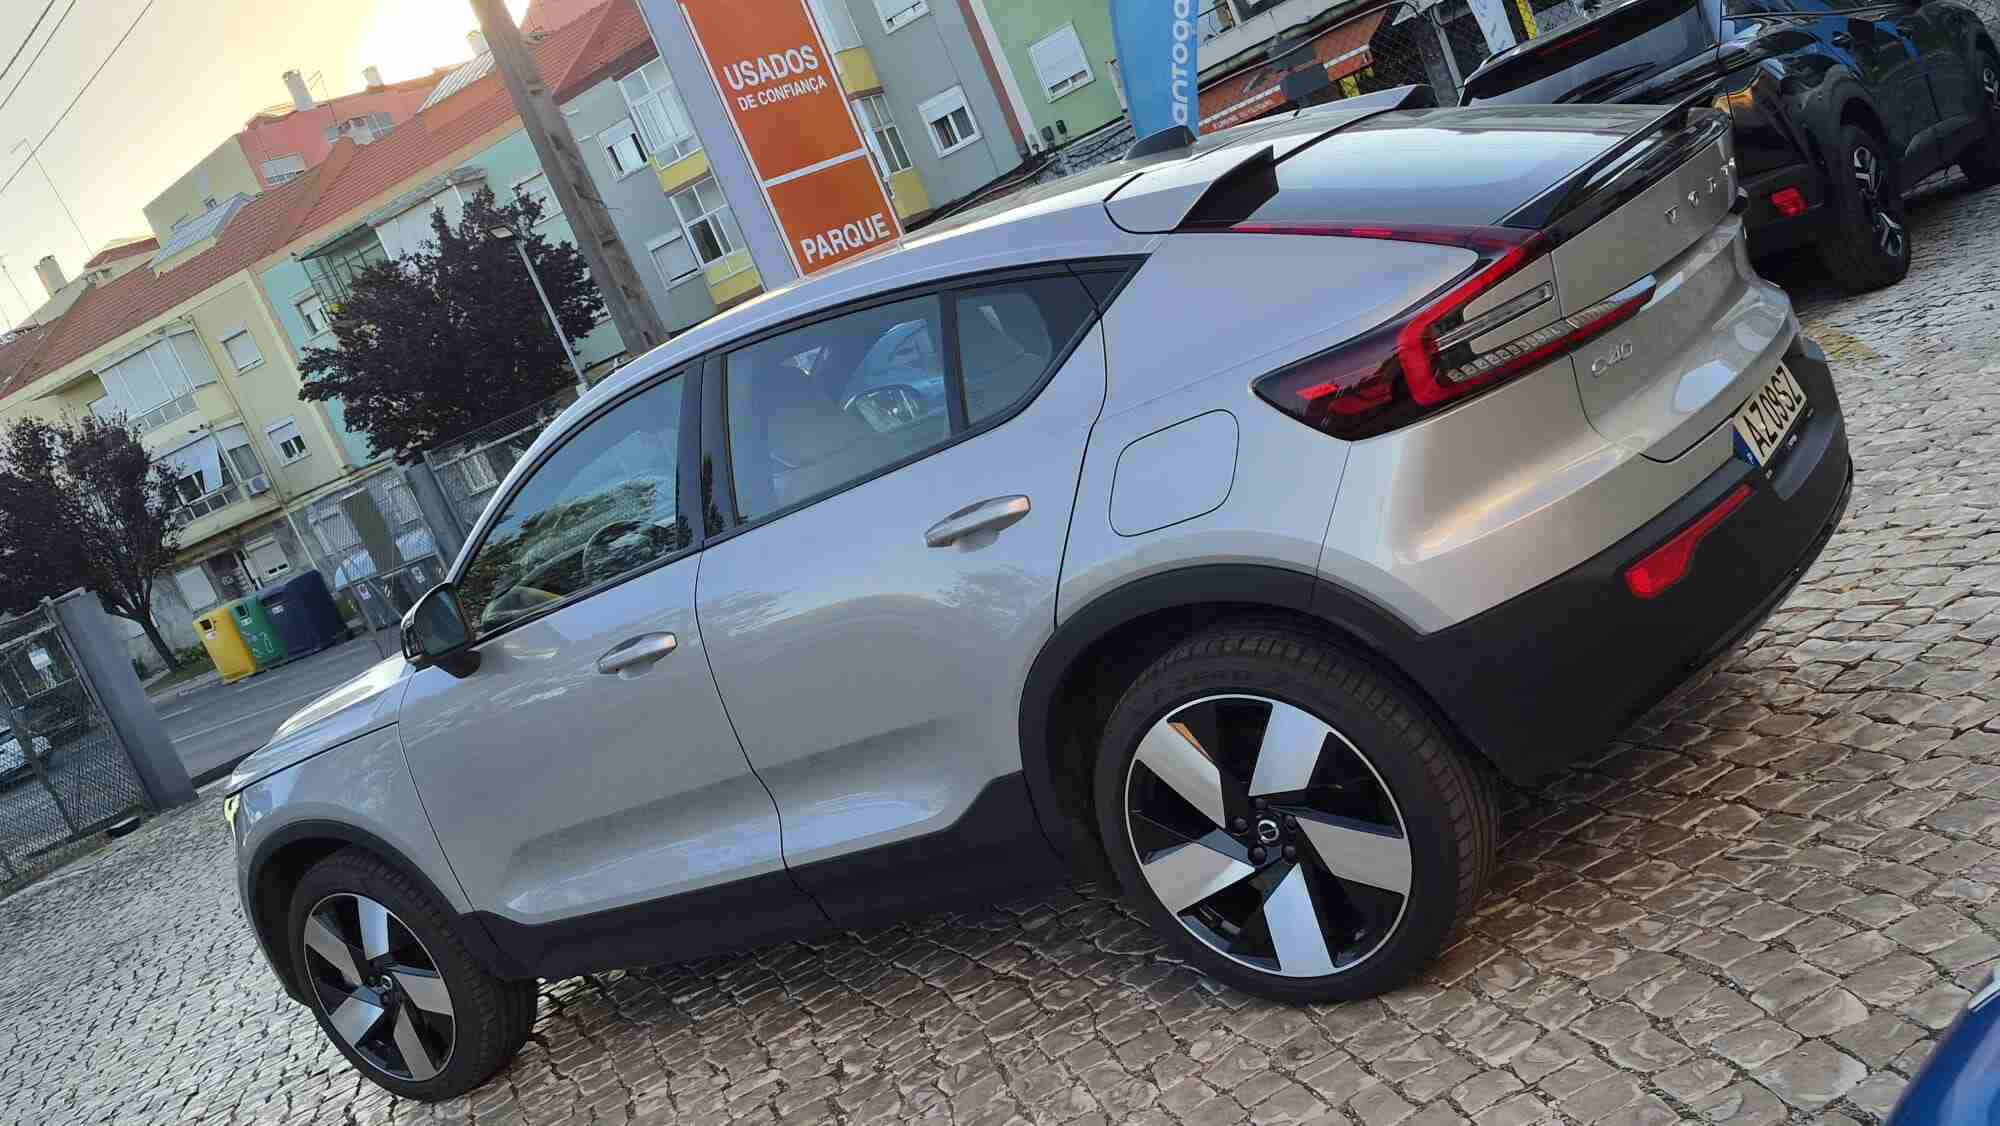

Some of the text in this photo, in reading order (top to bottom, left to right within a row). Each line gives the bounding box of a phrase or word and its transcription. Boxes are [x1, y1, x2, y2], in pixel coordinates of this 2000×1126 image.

[723, 45, 819, 90] USADOS
[737, 74, 829, 112] DE CONFIANÇA
[800, 212, 891, 264] PARQUE
[1591, 342, 1633, 377] C40
